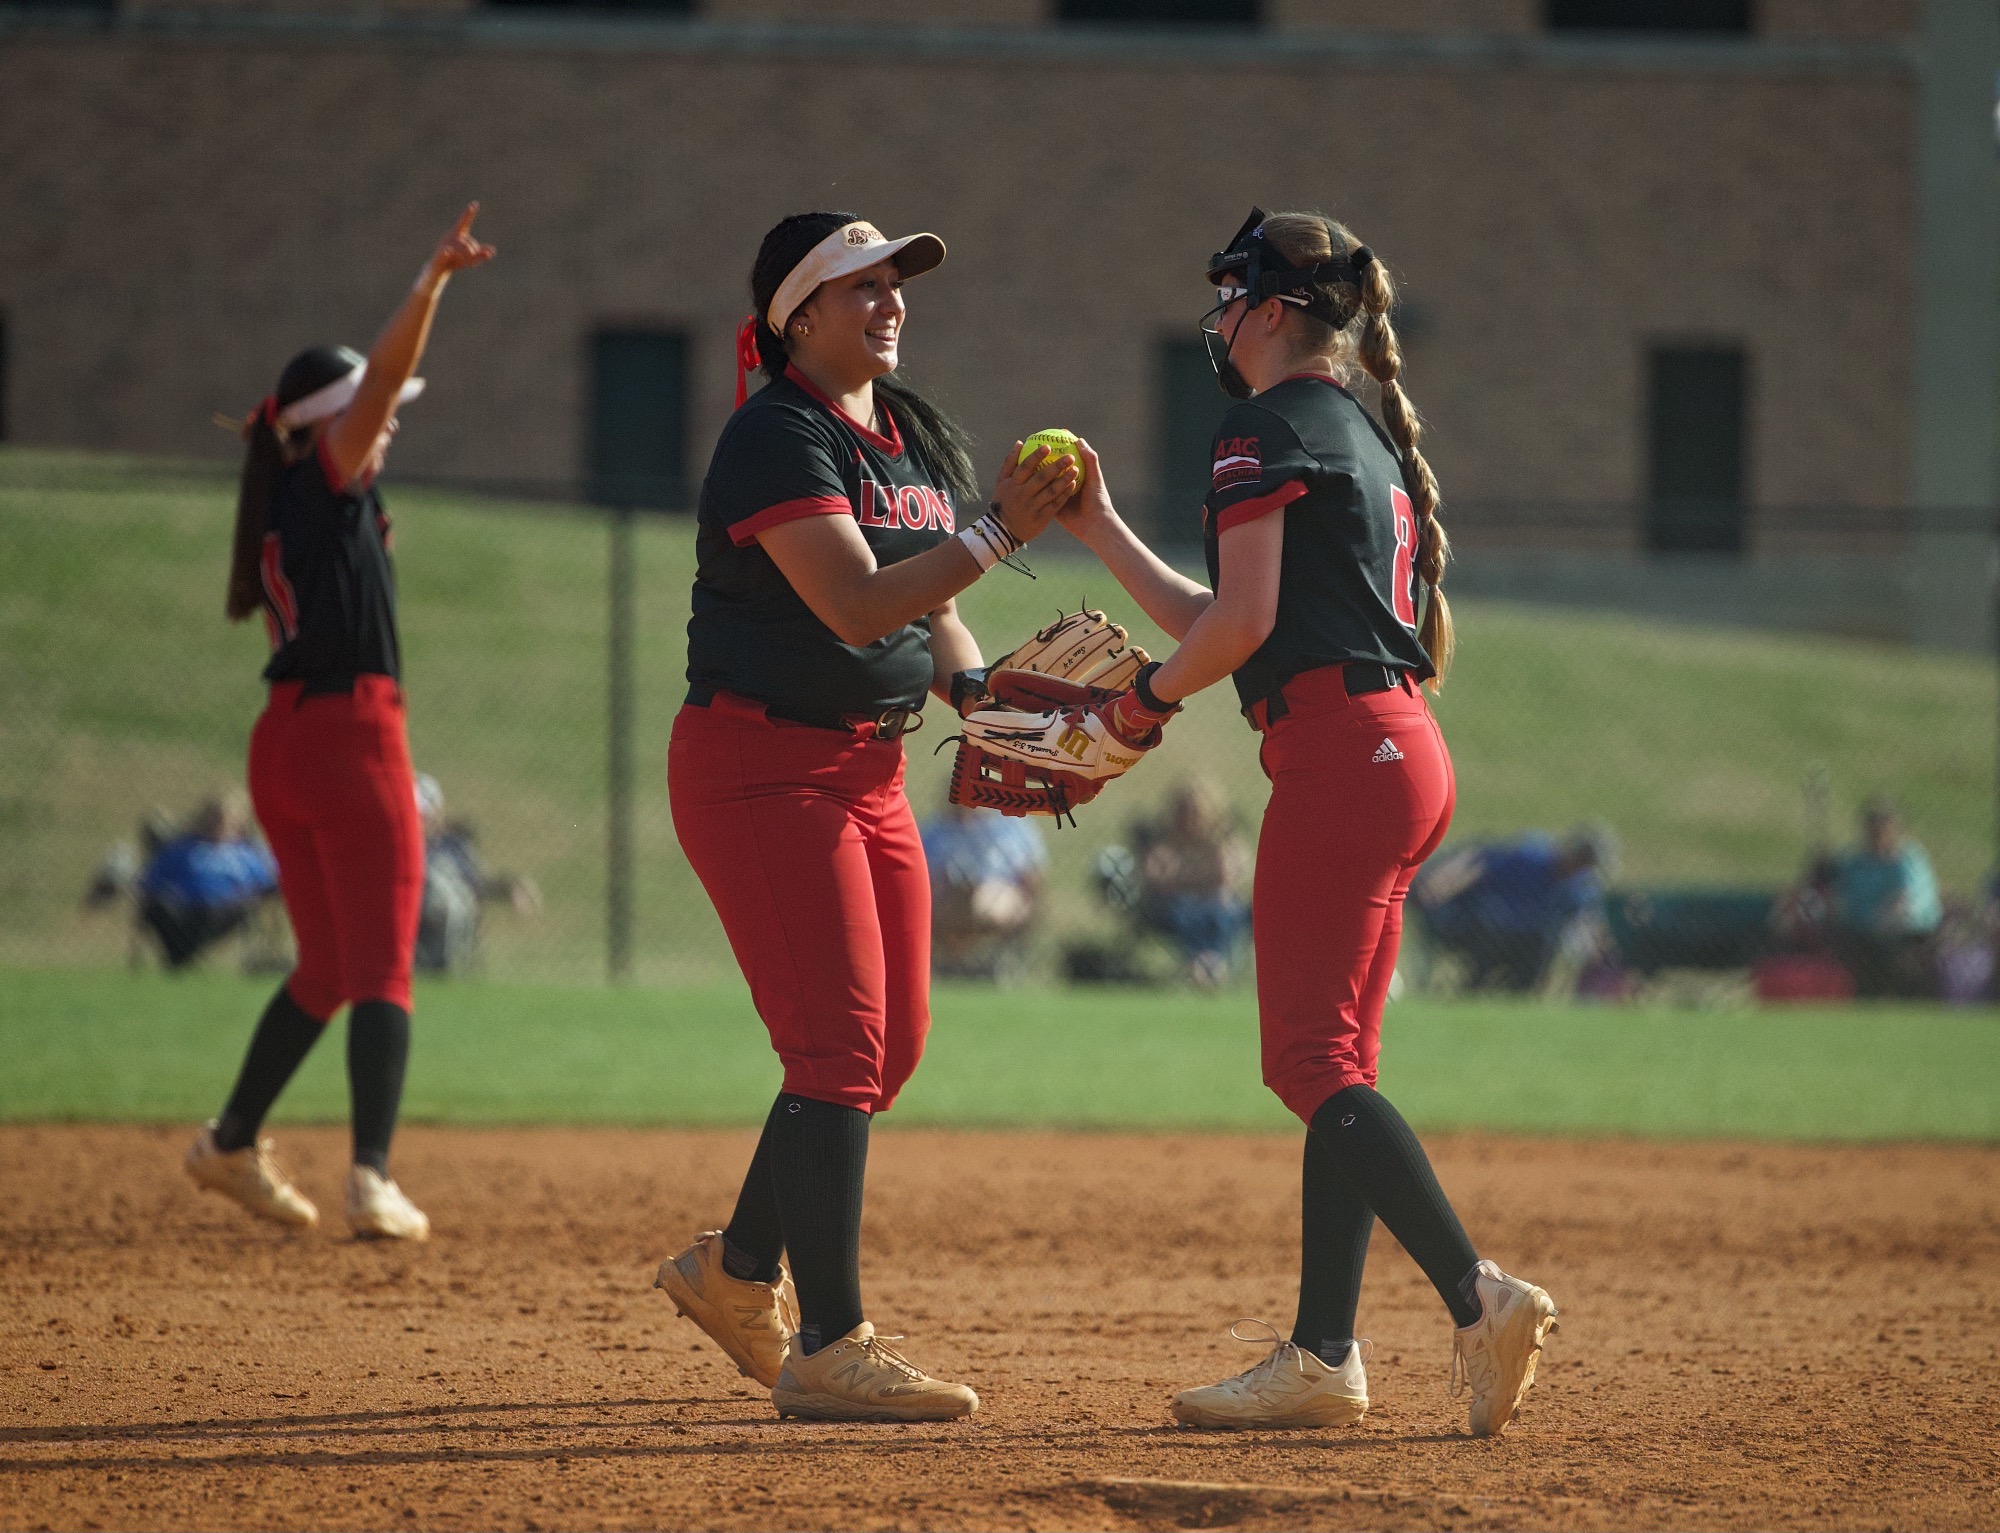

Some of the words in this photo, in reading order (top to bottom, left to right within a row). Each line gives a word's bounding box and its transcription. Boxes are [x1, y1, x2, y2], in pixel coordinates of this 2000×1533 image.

[1214, 436, 1260, 462] AAC
[858, 479, 955, 534] LIONS
[1372, 751, 1404, 763] adidas
